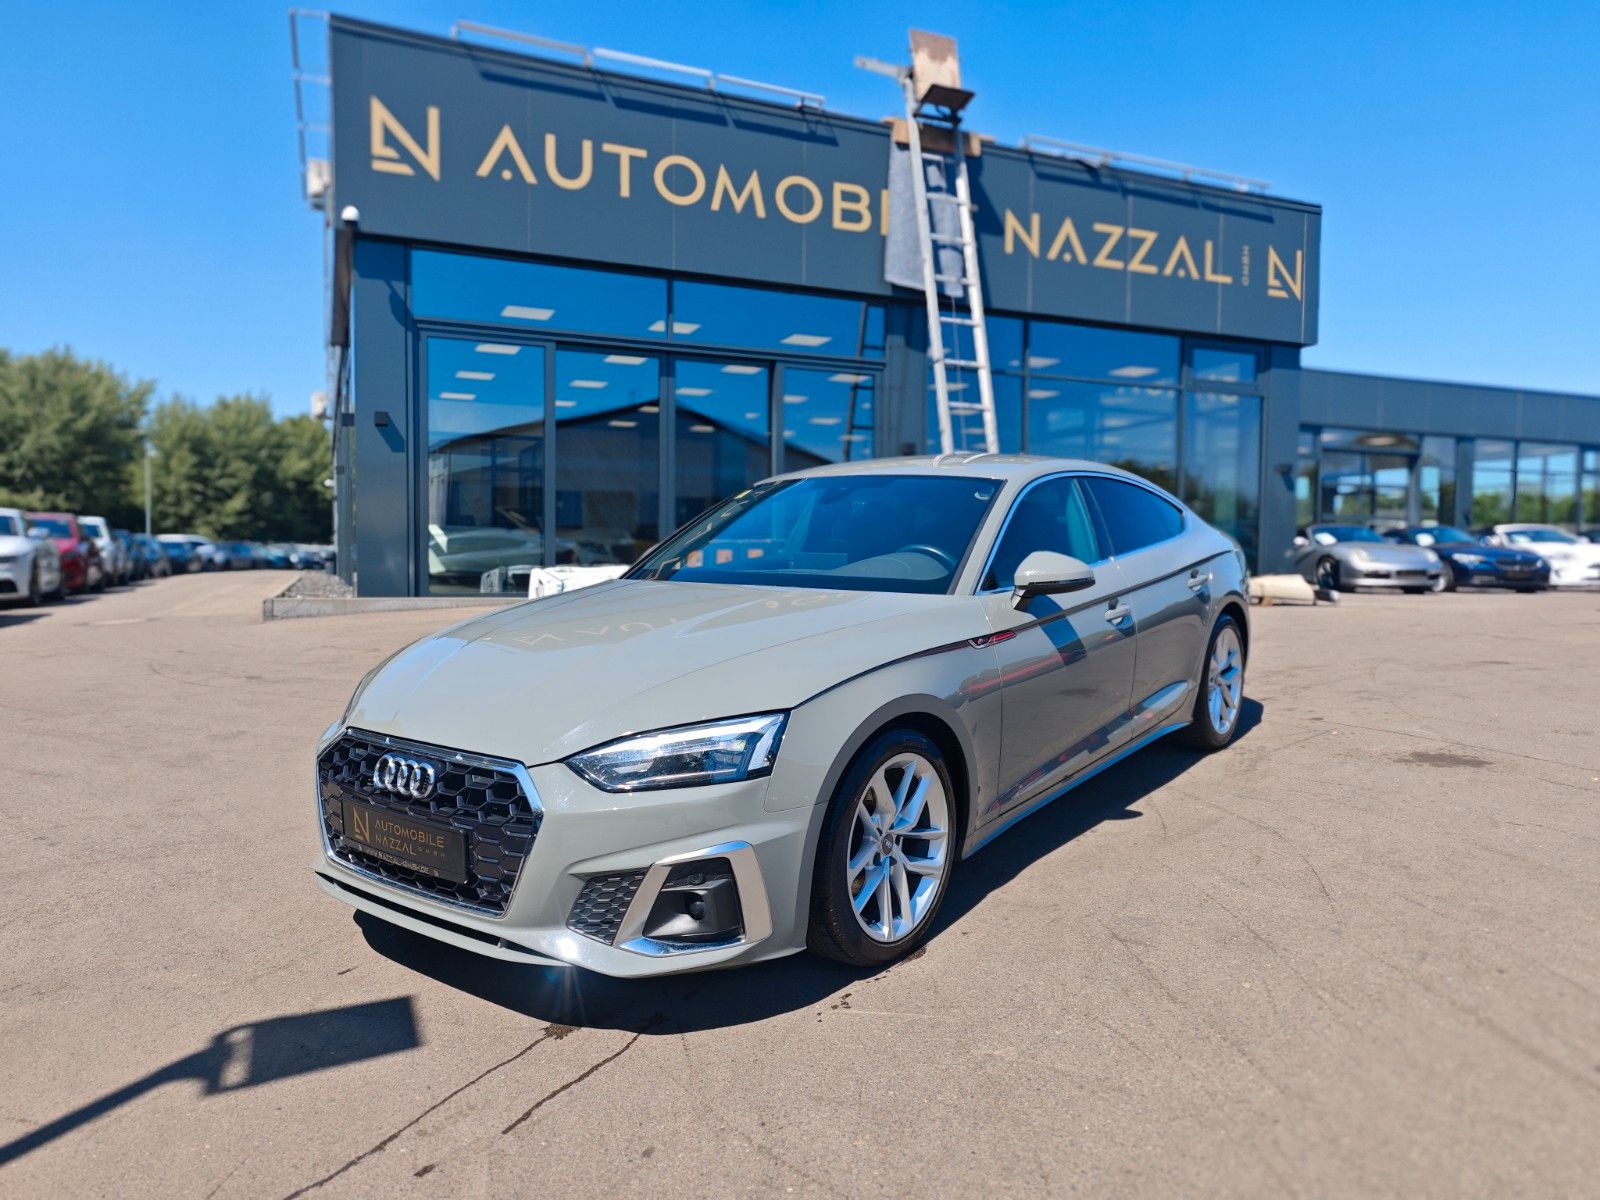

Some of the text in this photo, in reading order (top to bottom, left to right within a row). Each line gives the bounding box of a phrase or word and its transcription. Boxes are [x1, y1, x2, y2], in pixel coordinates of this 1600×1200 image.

[475, 124, 889, 236] AUTOMOBI
[1004, 208, 1233, 285] NAZZAL
[374, 819, 445, 848] AUTOMOBILE
[375, 834, 416, 856] NAZZAL
